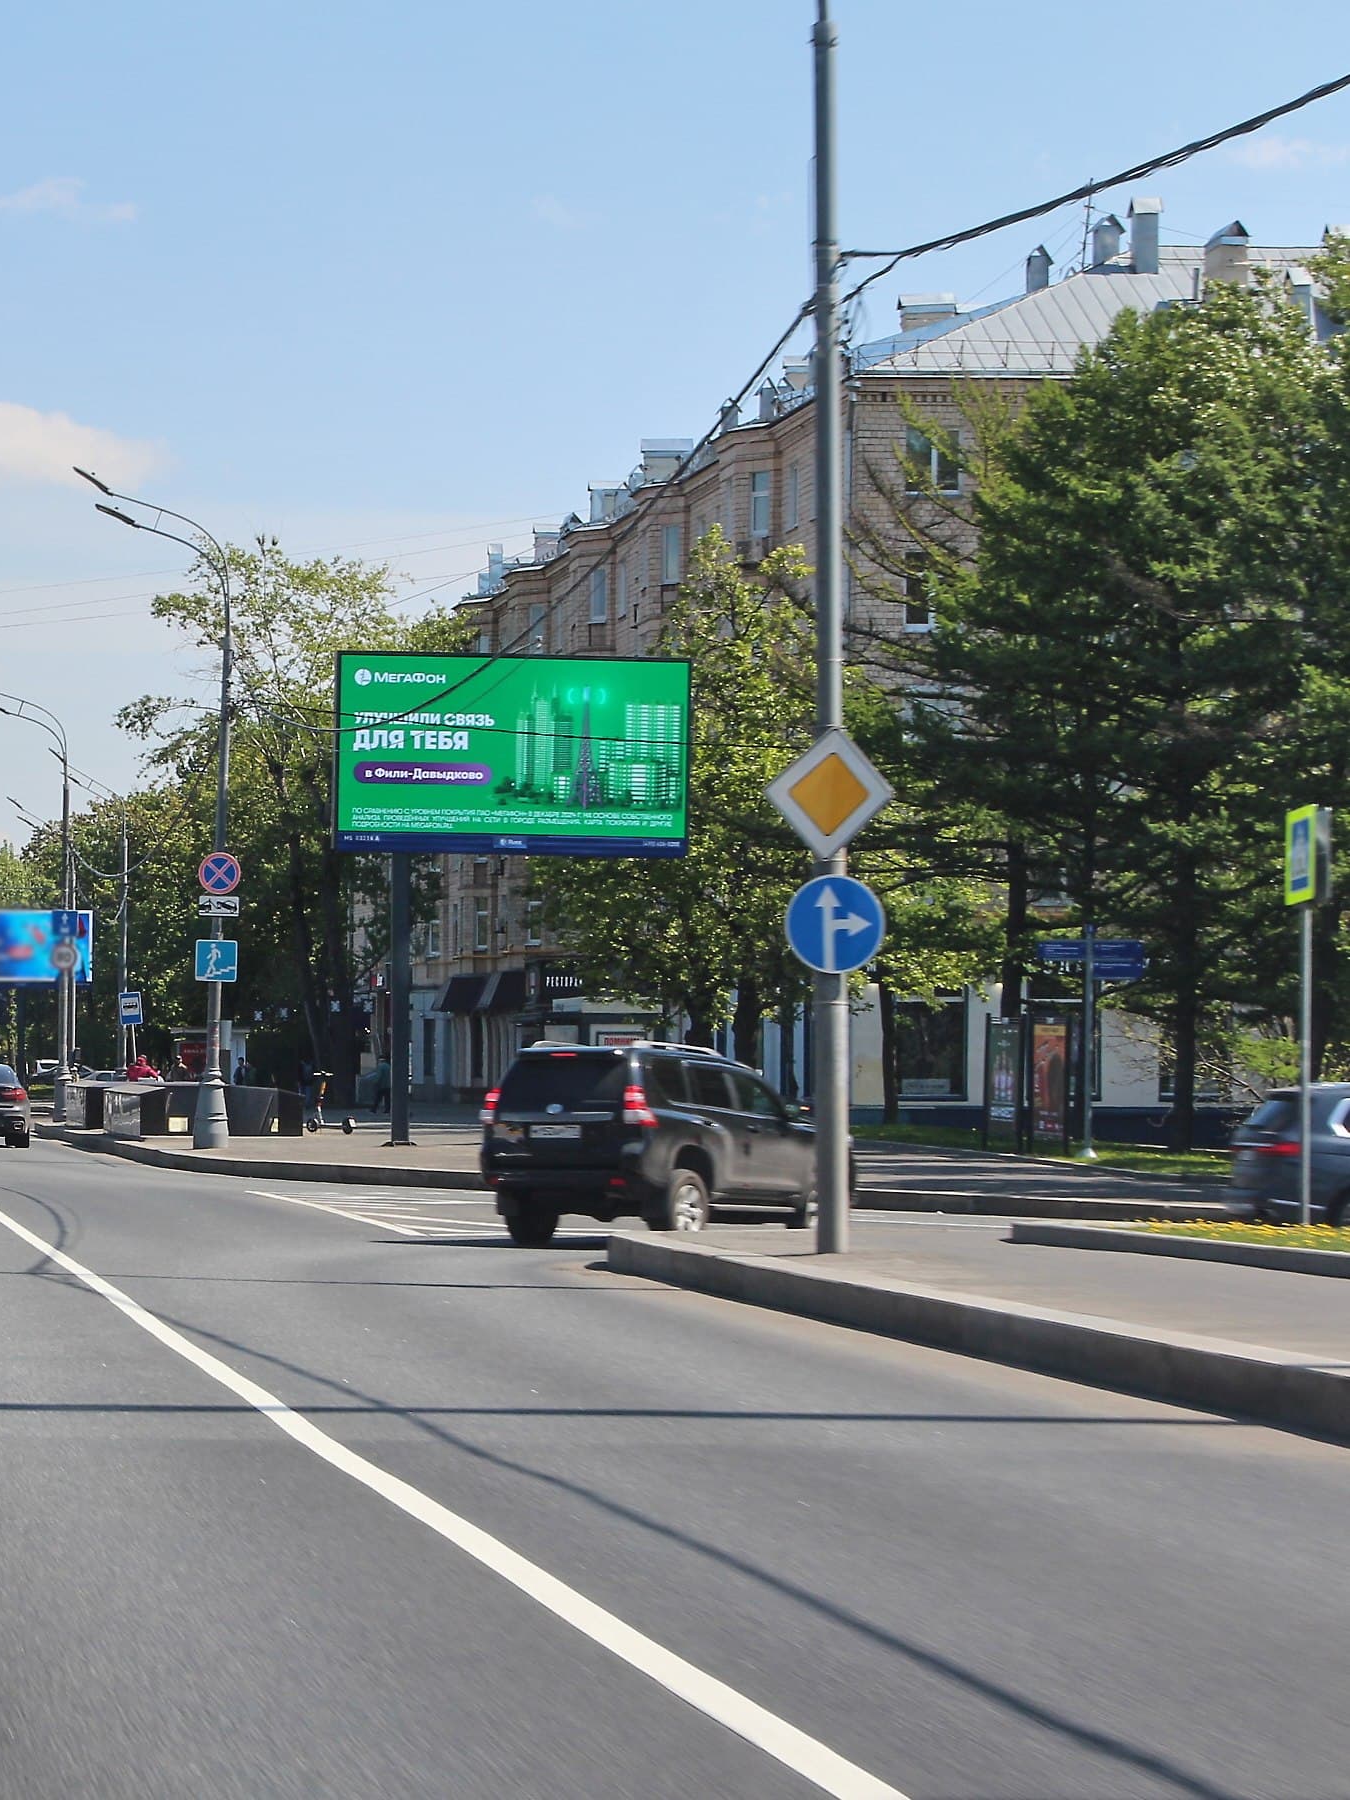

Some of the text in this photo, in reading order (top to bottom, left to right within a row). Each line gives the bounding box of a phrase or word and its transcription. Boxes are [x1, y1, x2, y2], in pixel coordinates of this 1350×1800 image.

[443, 713, 495, 727] СВЯЗЬ
[352, 729, 469, 751] ДЛЯ ТЕБЯ
[365, 767, 484, 781] в Фили-Давыдково
